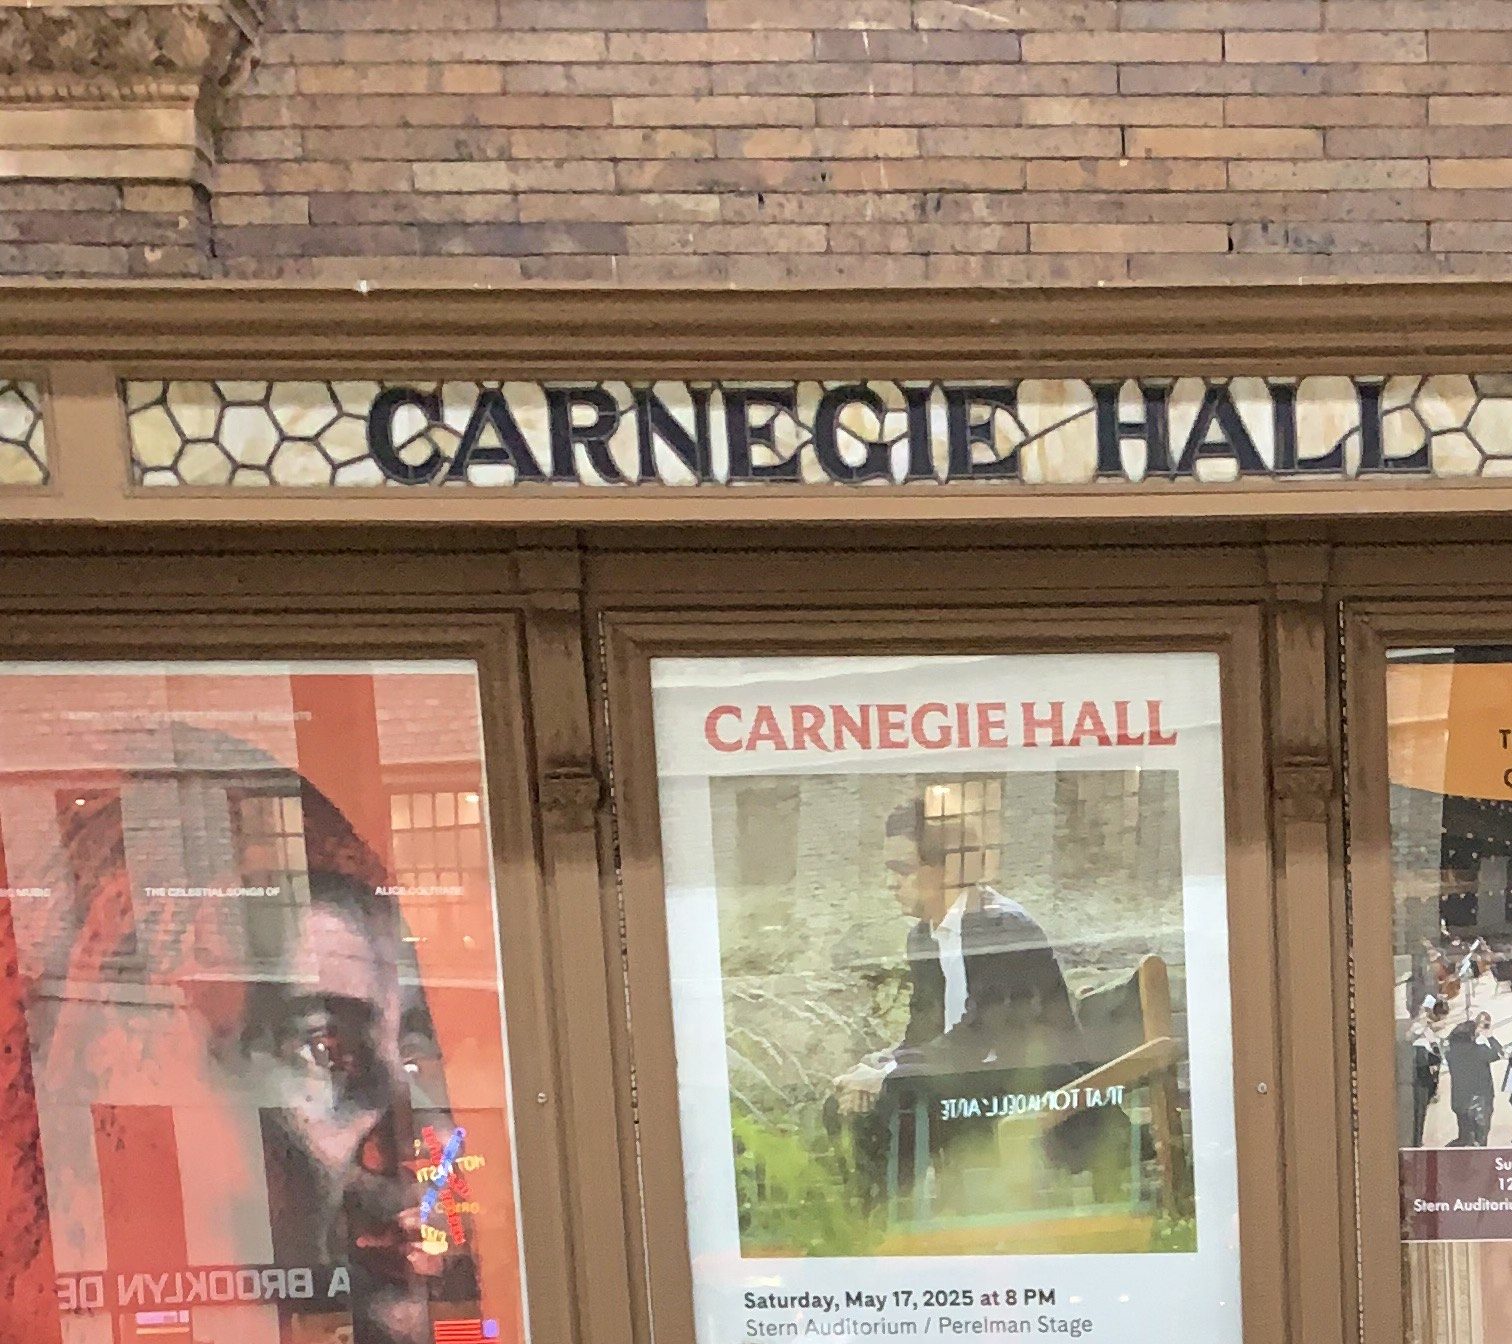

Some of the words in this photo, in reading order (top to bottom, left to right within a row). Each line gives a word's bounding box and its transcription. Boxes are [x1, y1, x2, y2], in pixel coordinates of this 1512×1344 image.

[367, 381, 1021, 485] CARNEGIE
[1094, 377, 1430, 480] HALL
[703, 702, 1009, 753] CARNEGIE
[1021, 700, 1179, 748] HALL
[1413, 1198, 1450, 1213] Stern
[744, 1291, 840, 1312] Saturday,
[845, 1291, 887, 1312] May
[893, 1290, 918, 1310] 17,
[923, 1289, 974, 1307] 2025
[980, 1290, 1000, 1306] at
[1006, 1289, 1018, 1306] 8
[1024, 1288, 1056, 1306] PM
[746, 1318, 798, 1337] Stern
[805, 1317, 917, 1336] Auditorium
[924, 1317, 931, 1334] /
[939, 1315, 1031, 1334] Perelman
[1037, 1315, 1093, 1337] Stage
